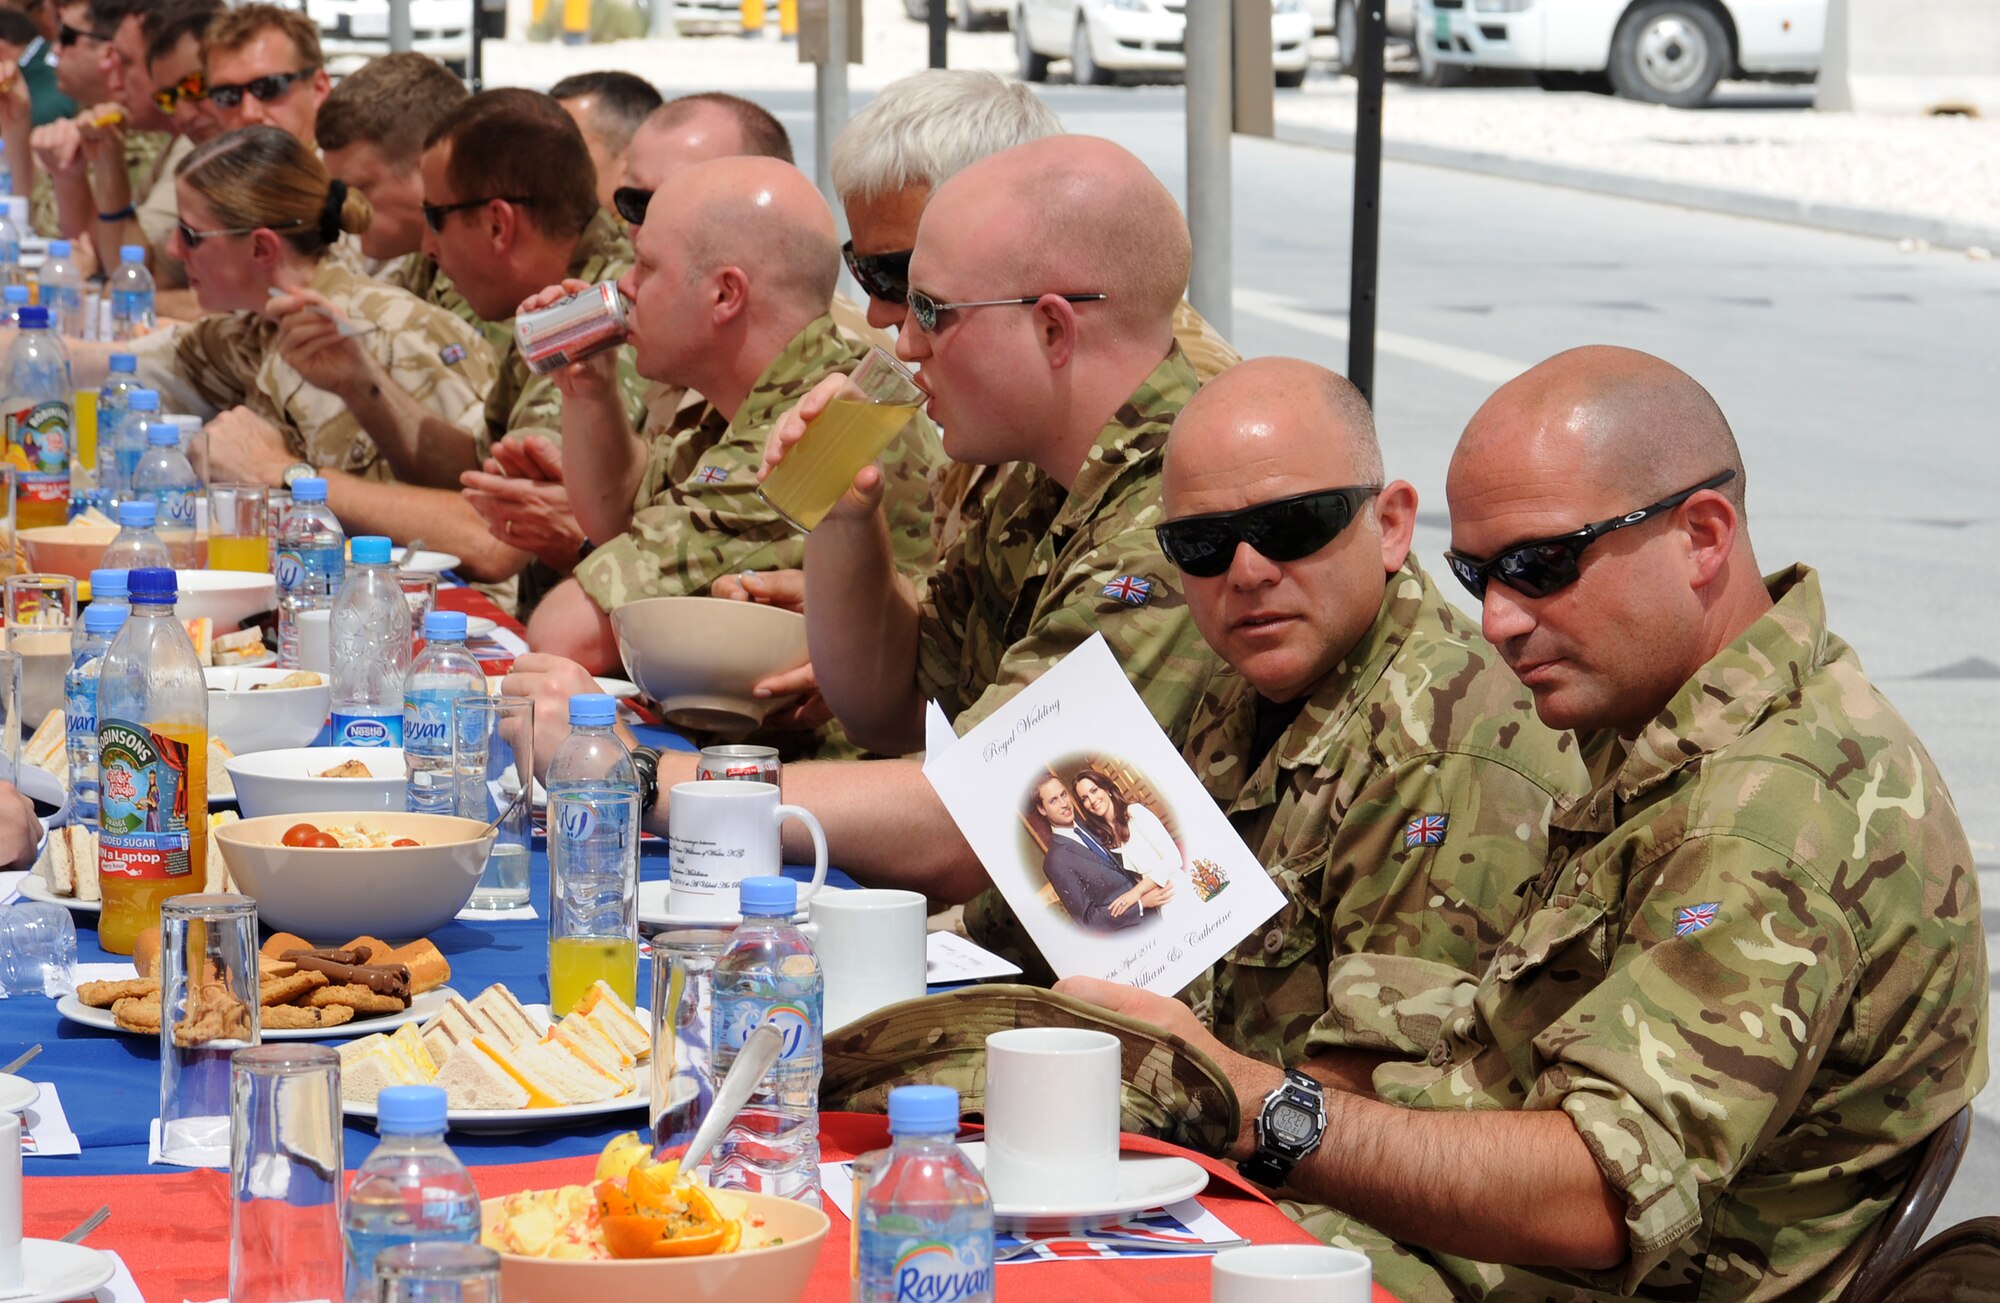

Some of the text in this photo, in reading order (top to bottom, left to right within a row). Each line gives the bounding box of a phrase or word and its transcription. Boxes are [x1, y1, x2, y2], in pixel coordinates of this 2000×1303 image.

[982, 699, 1061, 763] Royal Wedding
[114, 850, 161, 865] Laptop
[123, 837, 156, 848] SUGAR
[1183, 909, 1232, 947] Catherine
[896, 1267, 990, 1303] Rayyan
